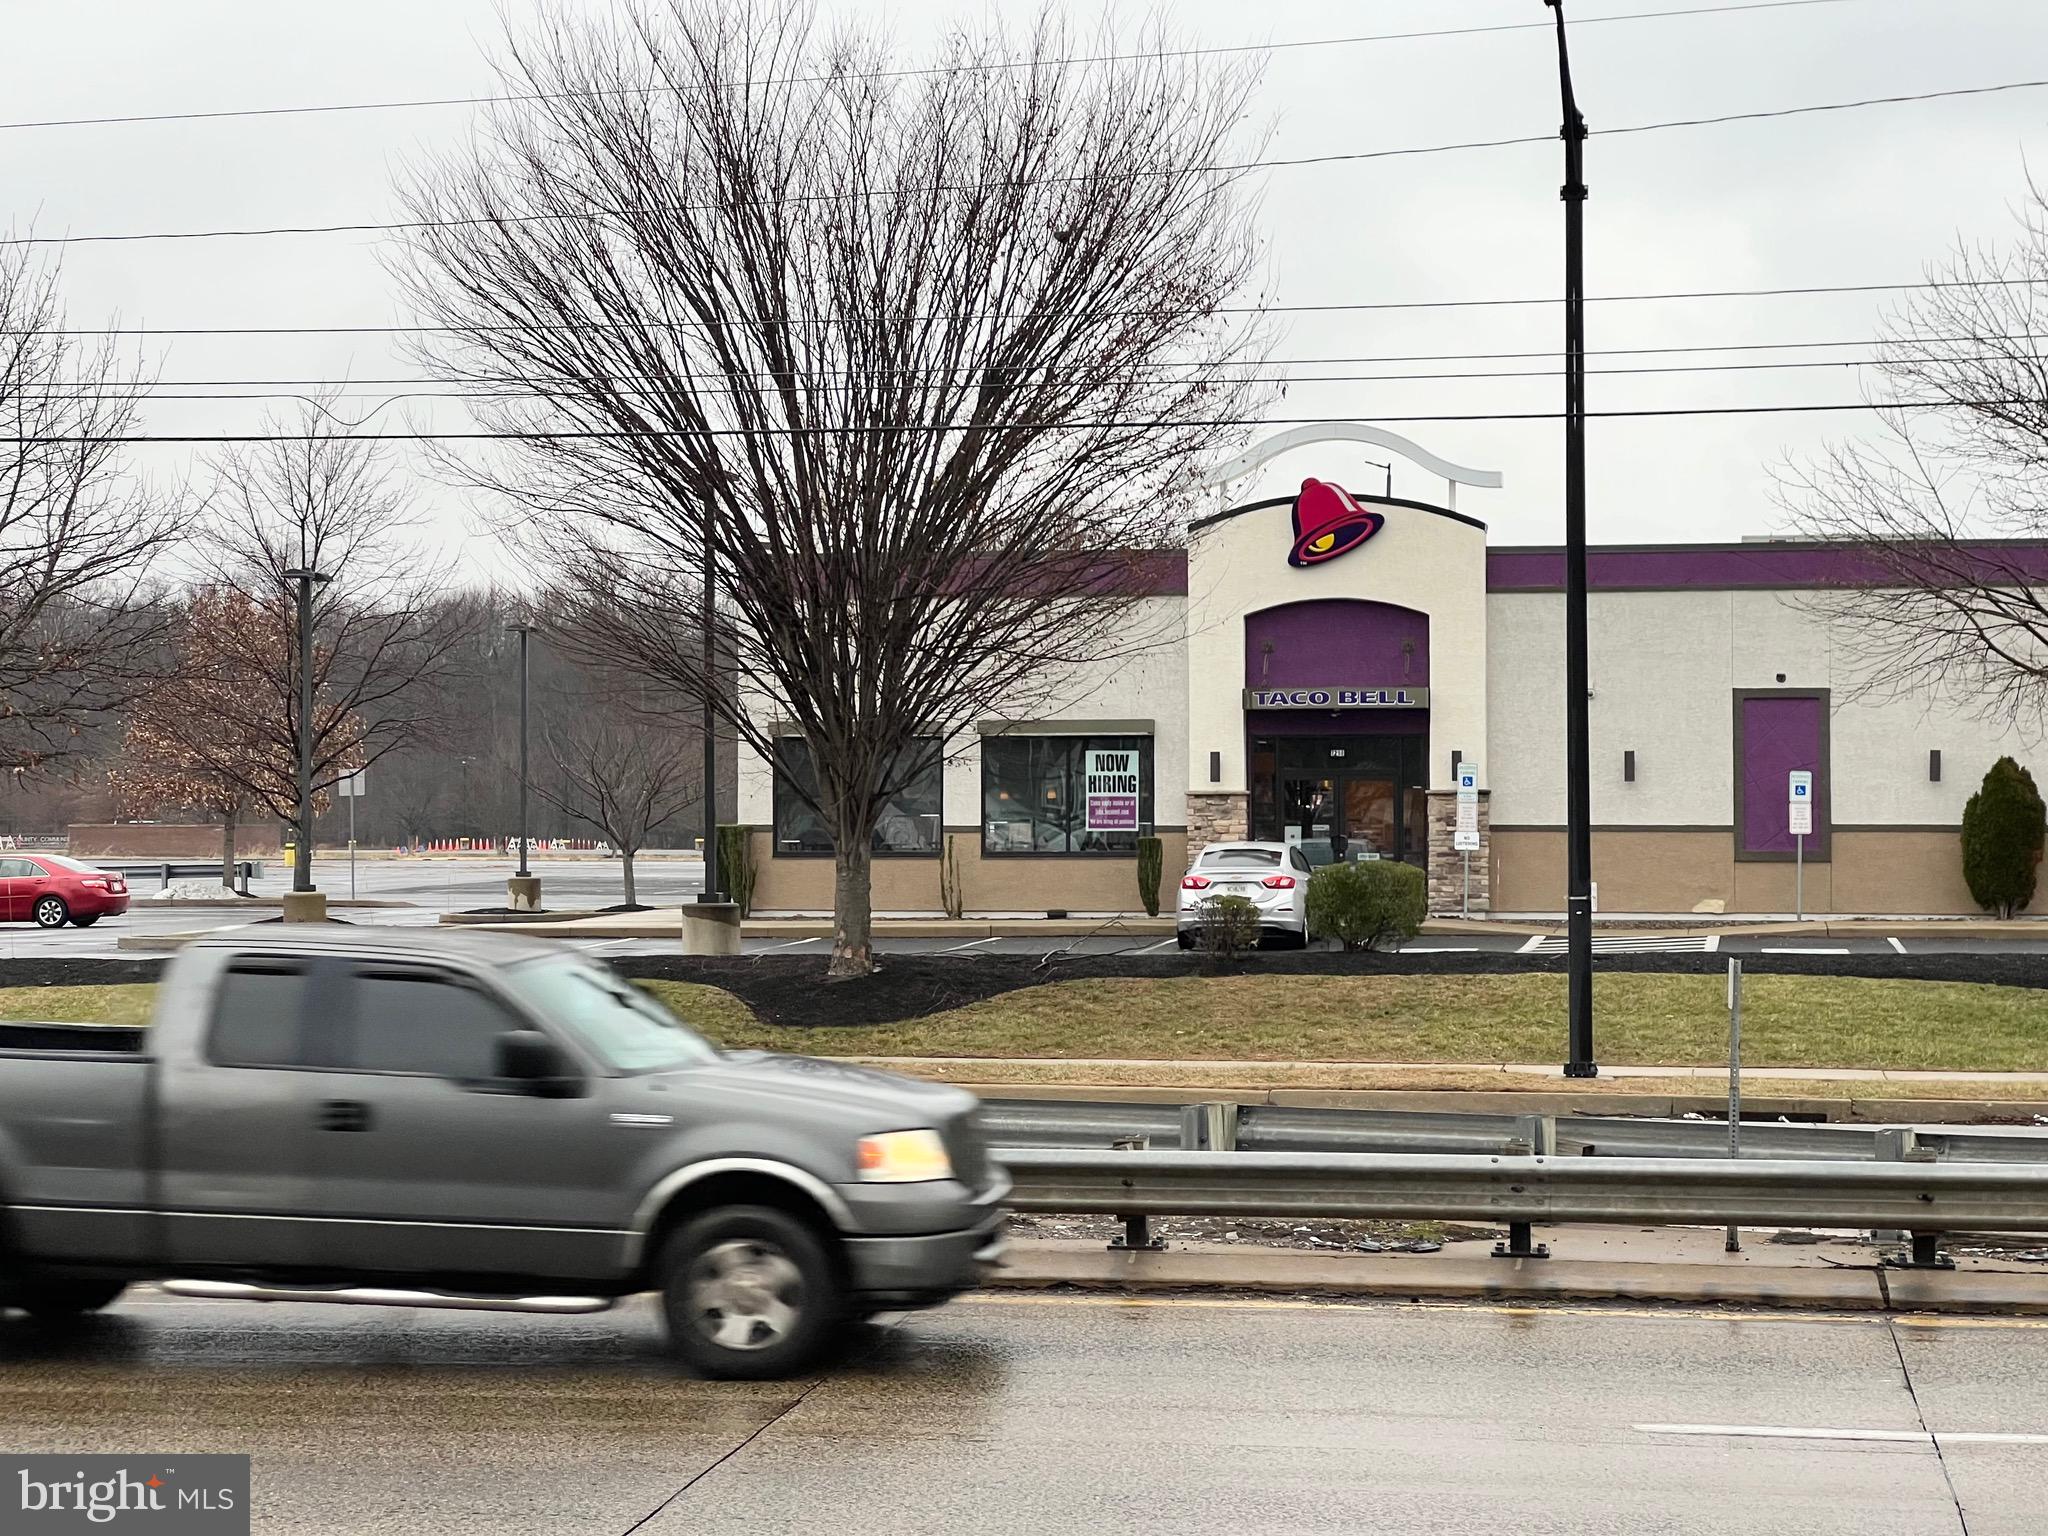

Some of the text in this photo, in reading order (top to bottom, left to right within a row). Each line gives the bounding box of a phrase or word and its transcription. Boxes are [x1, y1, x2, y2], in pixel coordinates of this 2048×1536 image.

[1254, 690, 1415, 706] TACO BELL
[1095, 754, 1130, 772] NOW
[1088, 775, 1137, 793] HIRING
